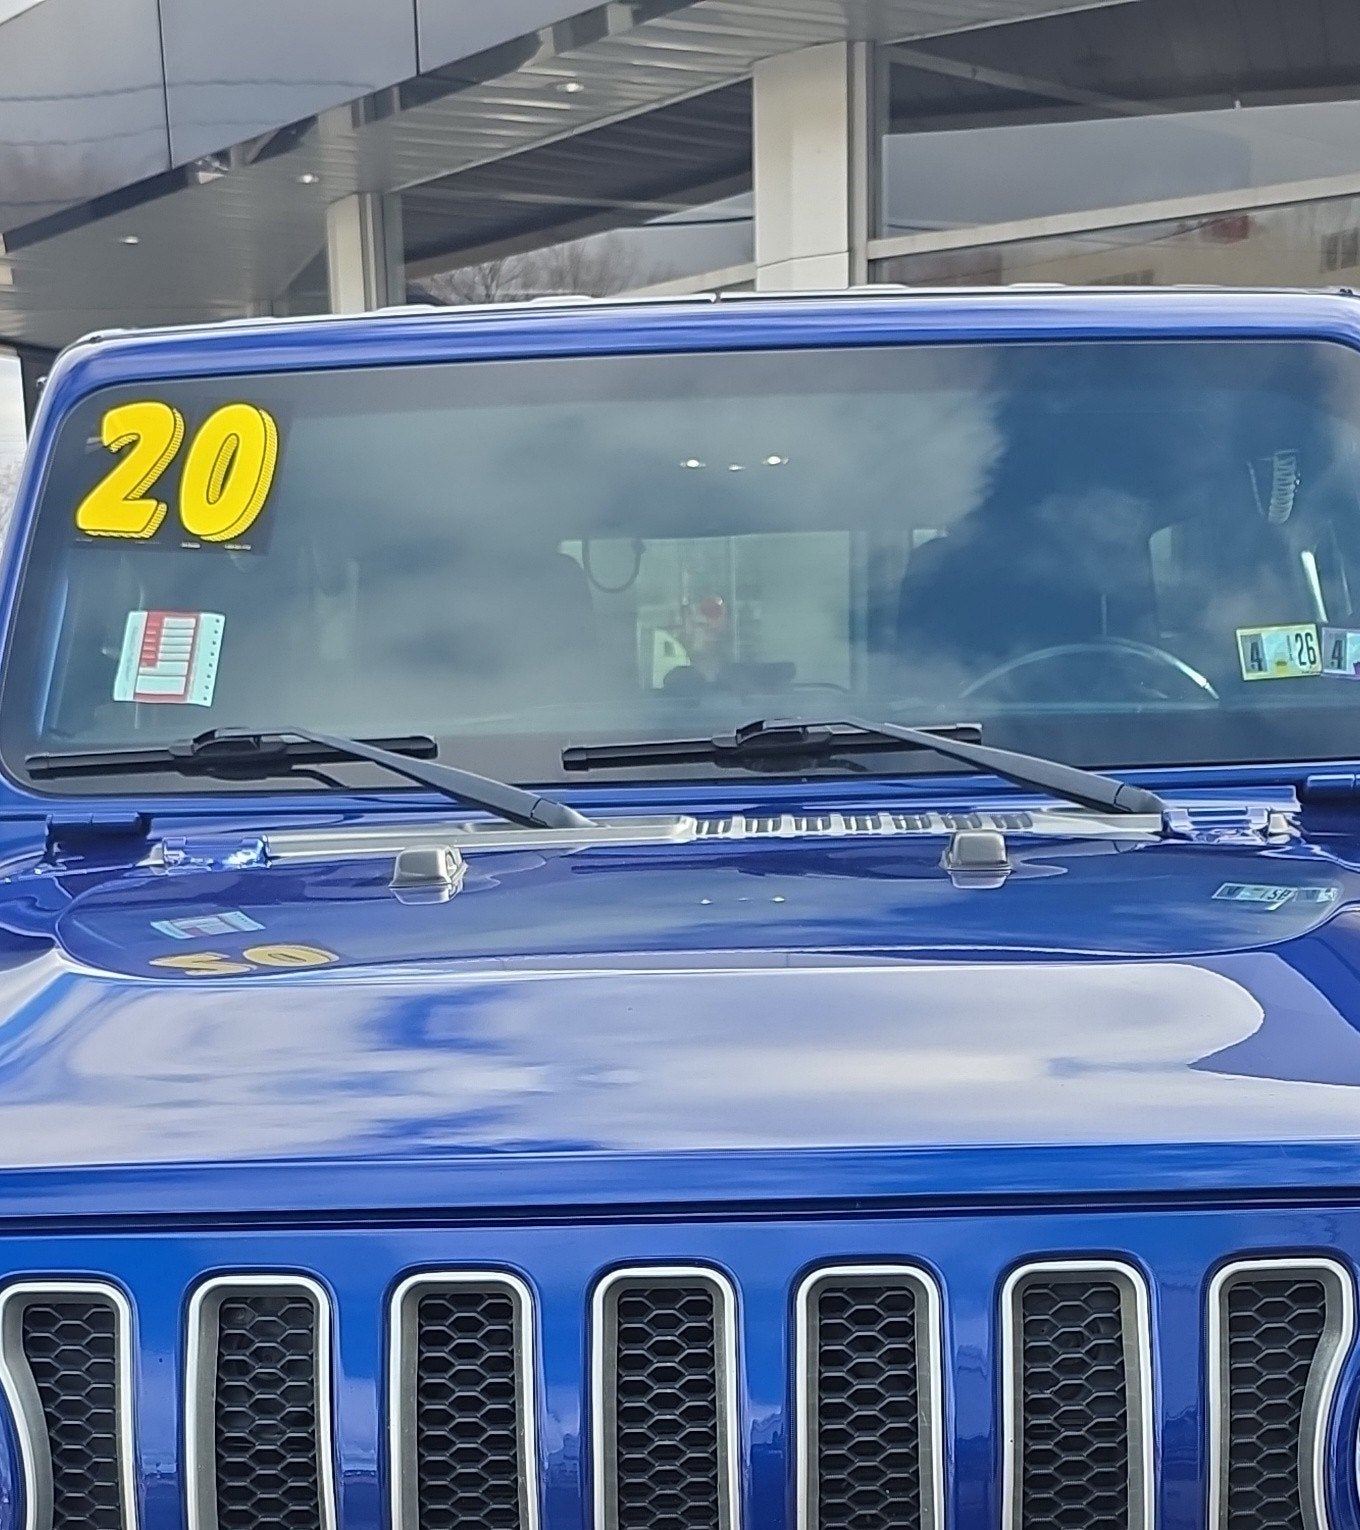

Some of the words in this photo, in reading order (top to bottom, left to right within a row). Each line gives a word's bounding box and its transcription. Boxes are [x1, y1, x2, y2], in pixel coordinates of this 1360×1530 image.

[75, 400, 278, 543] 20
[1250, 640, 1264, 672] 4
[1294, 631, 1317, 666] 26
[1331, 639, 1343, 671] 4
